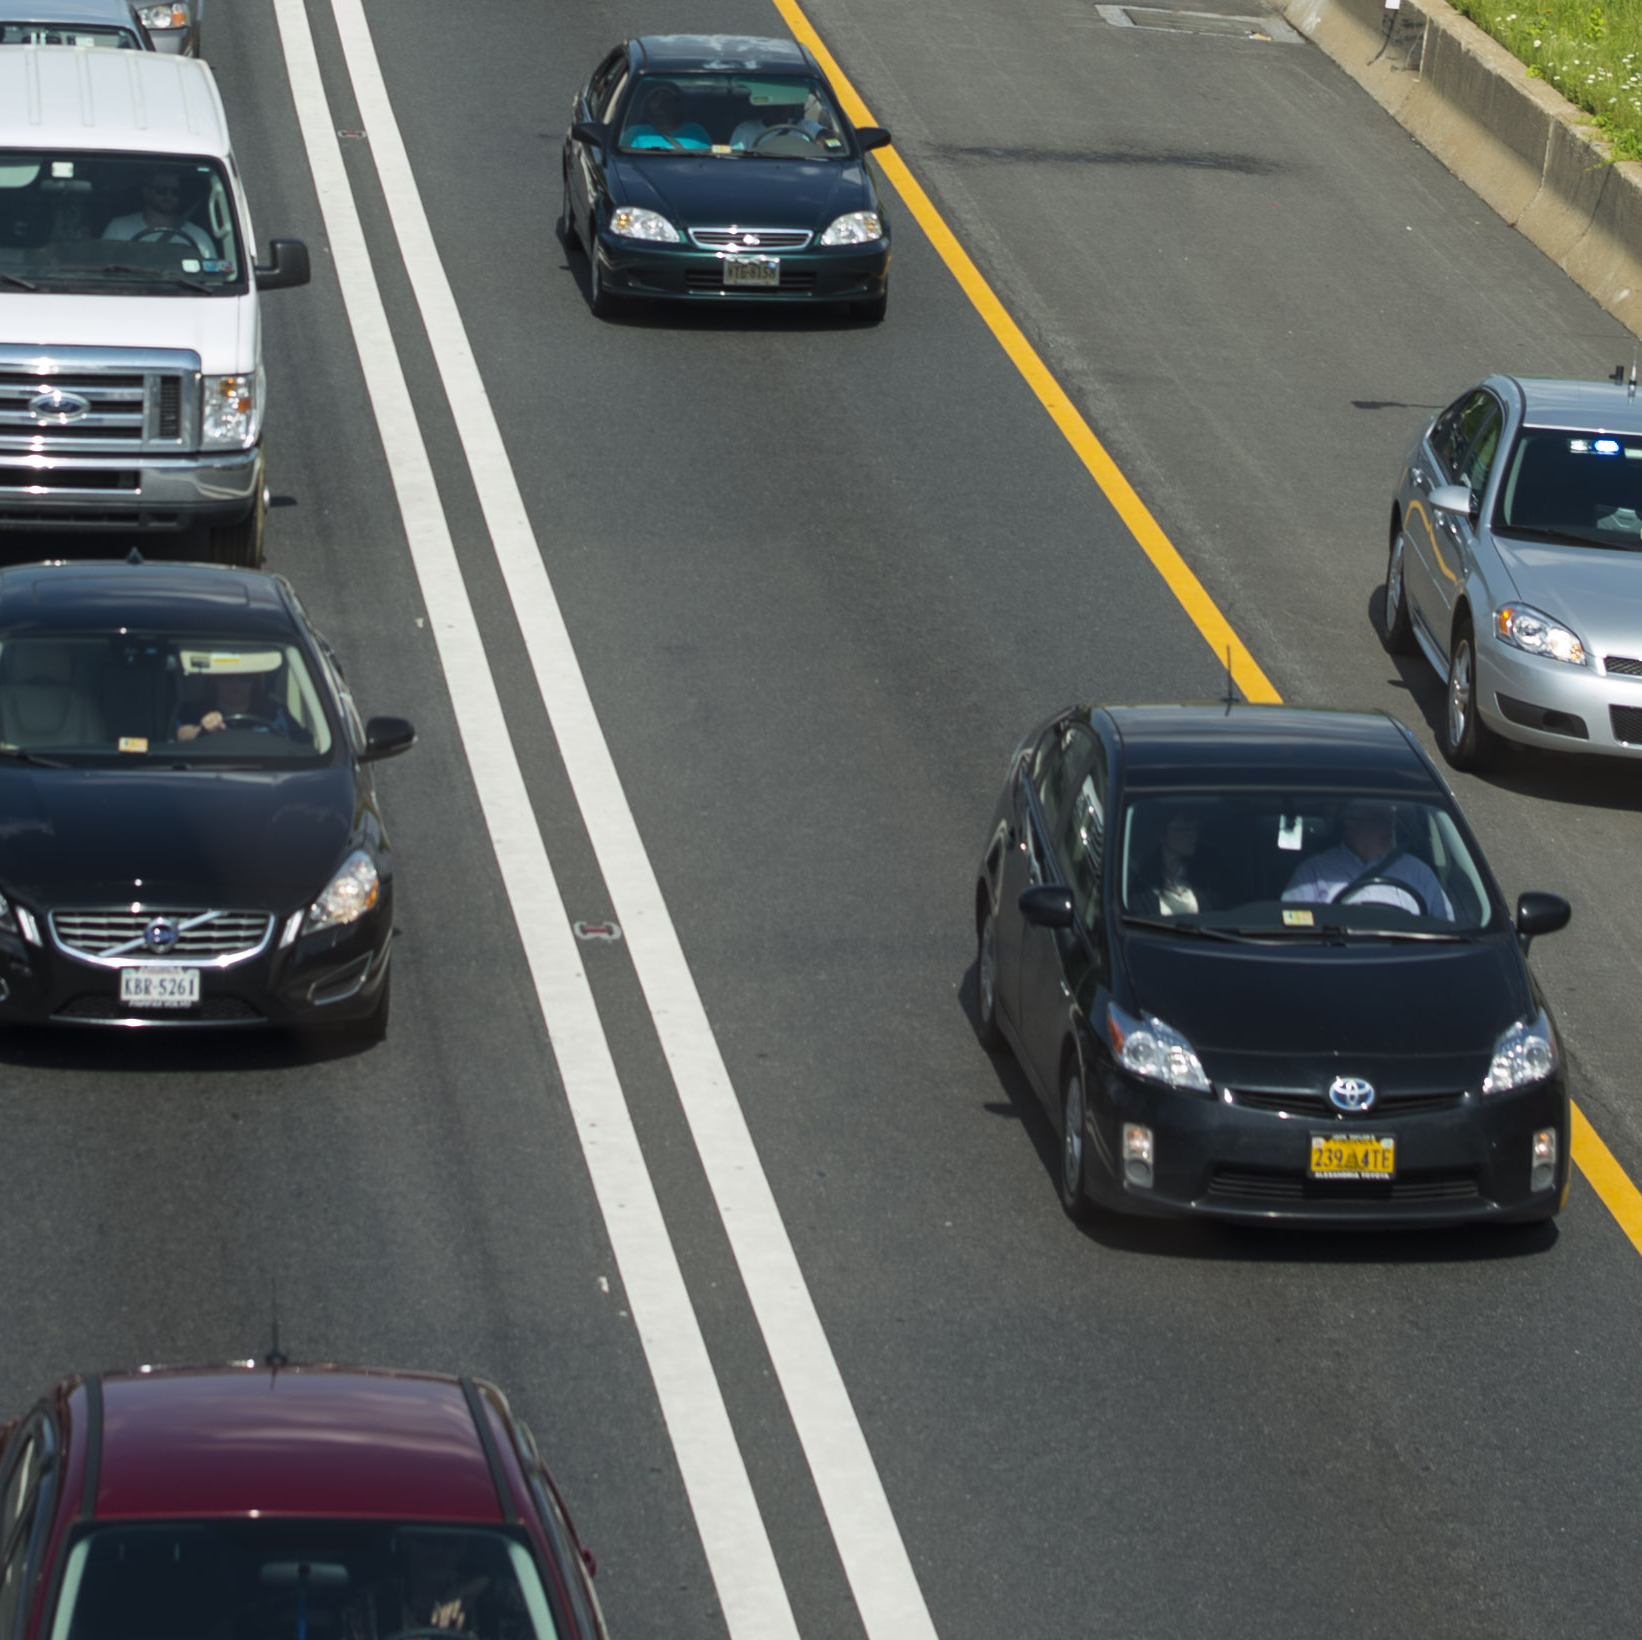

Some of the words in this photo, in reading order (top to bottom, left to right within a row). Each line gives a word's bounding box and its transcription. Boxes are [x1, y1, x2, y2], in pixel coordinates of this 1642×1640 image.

[124, 978, 194, 996] KBR-5261
[1315, 1148, 1343, 1167] 239
[1361, 1148, 1390, 1169] 4TE
